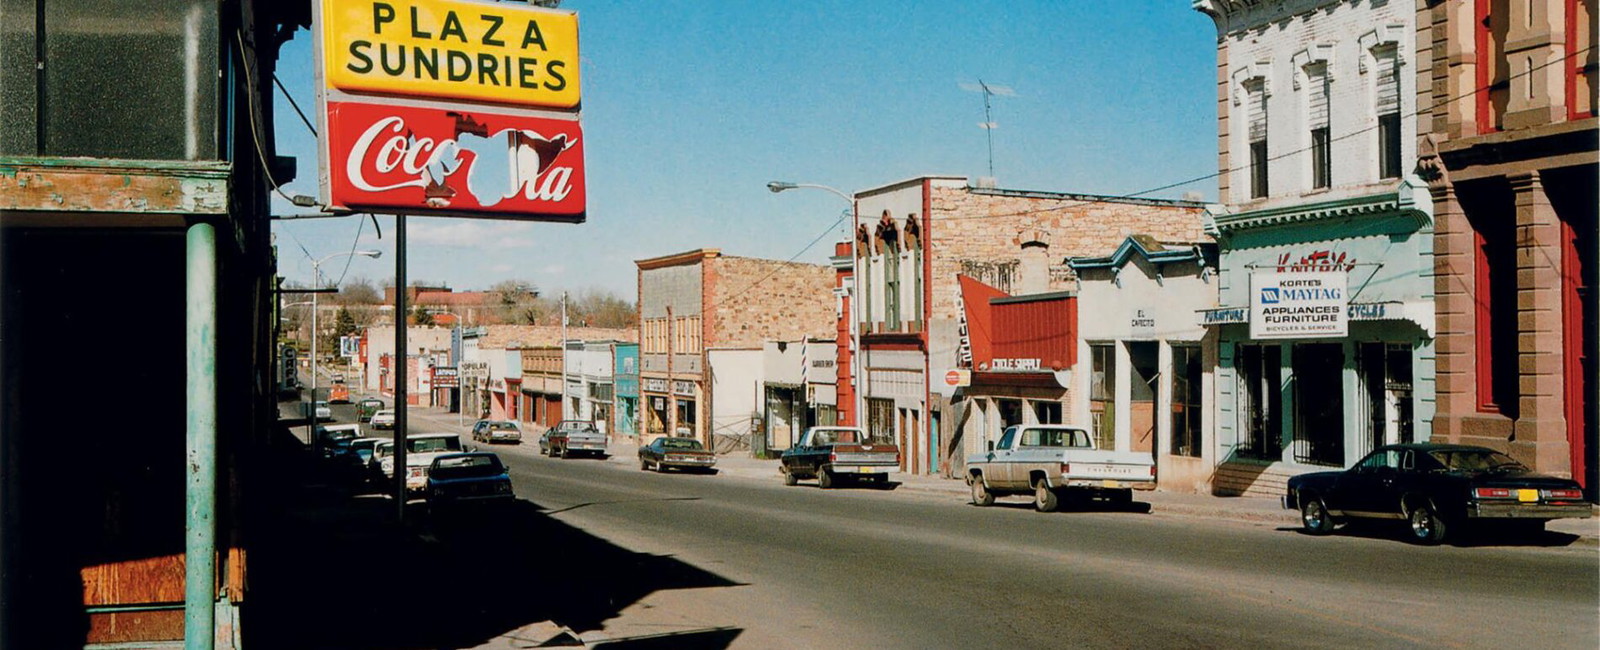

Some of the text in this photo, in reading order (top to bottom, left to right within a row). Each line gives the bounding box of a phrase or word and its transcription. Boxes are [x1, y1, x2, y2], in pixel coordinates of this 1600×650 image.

[372, 2, 548, 52] PLAZA
[346, 39, 567, 92] SUNDRIES
[1282, 288, 1341, 301] MAYTAG
[1137, 309, 1145, 318] EL
[1262, 305, 1341, 315] APPLIANCES
[1265, 314, 1338, 324] FURNITURE
